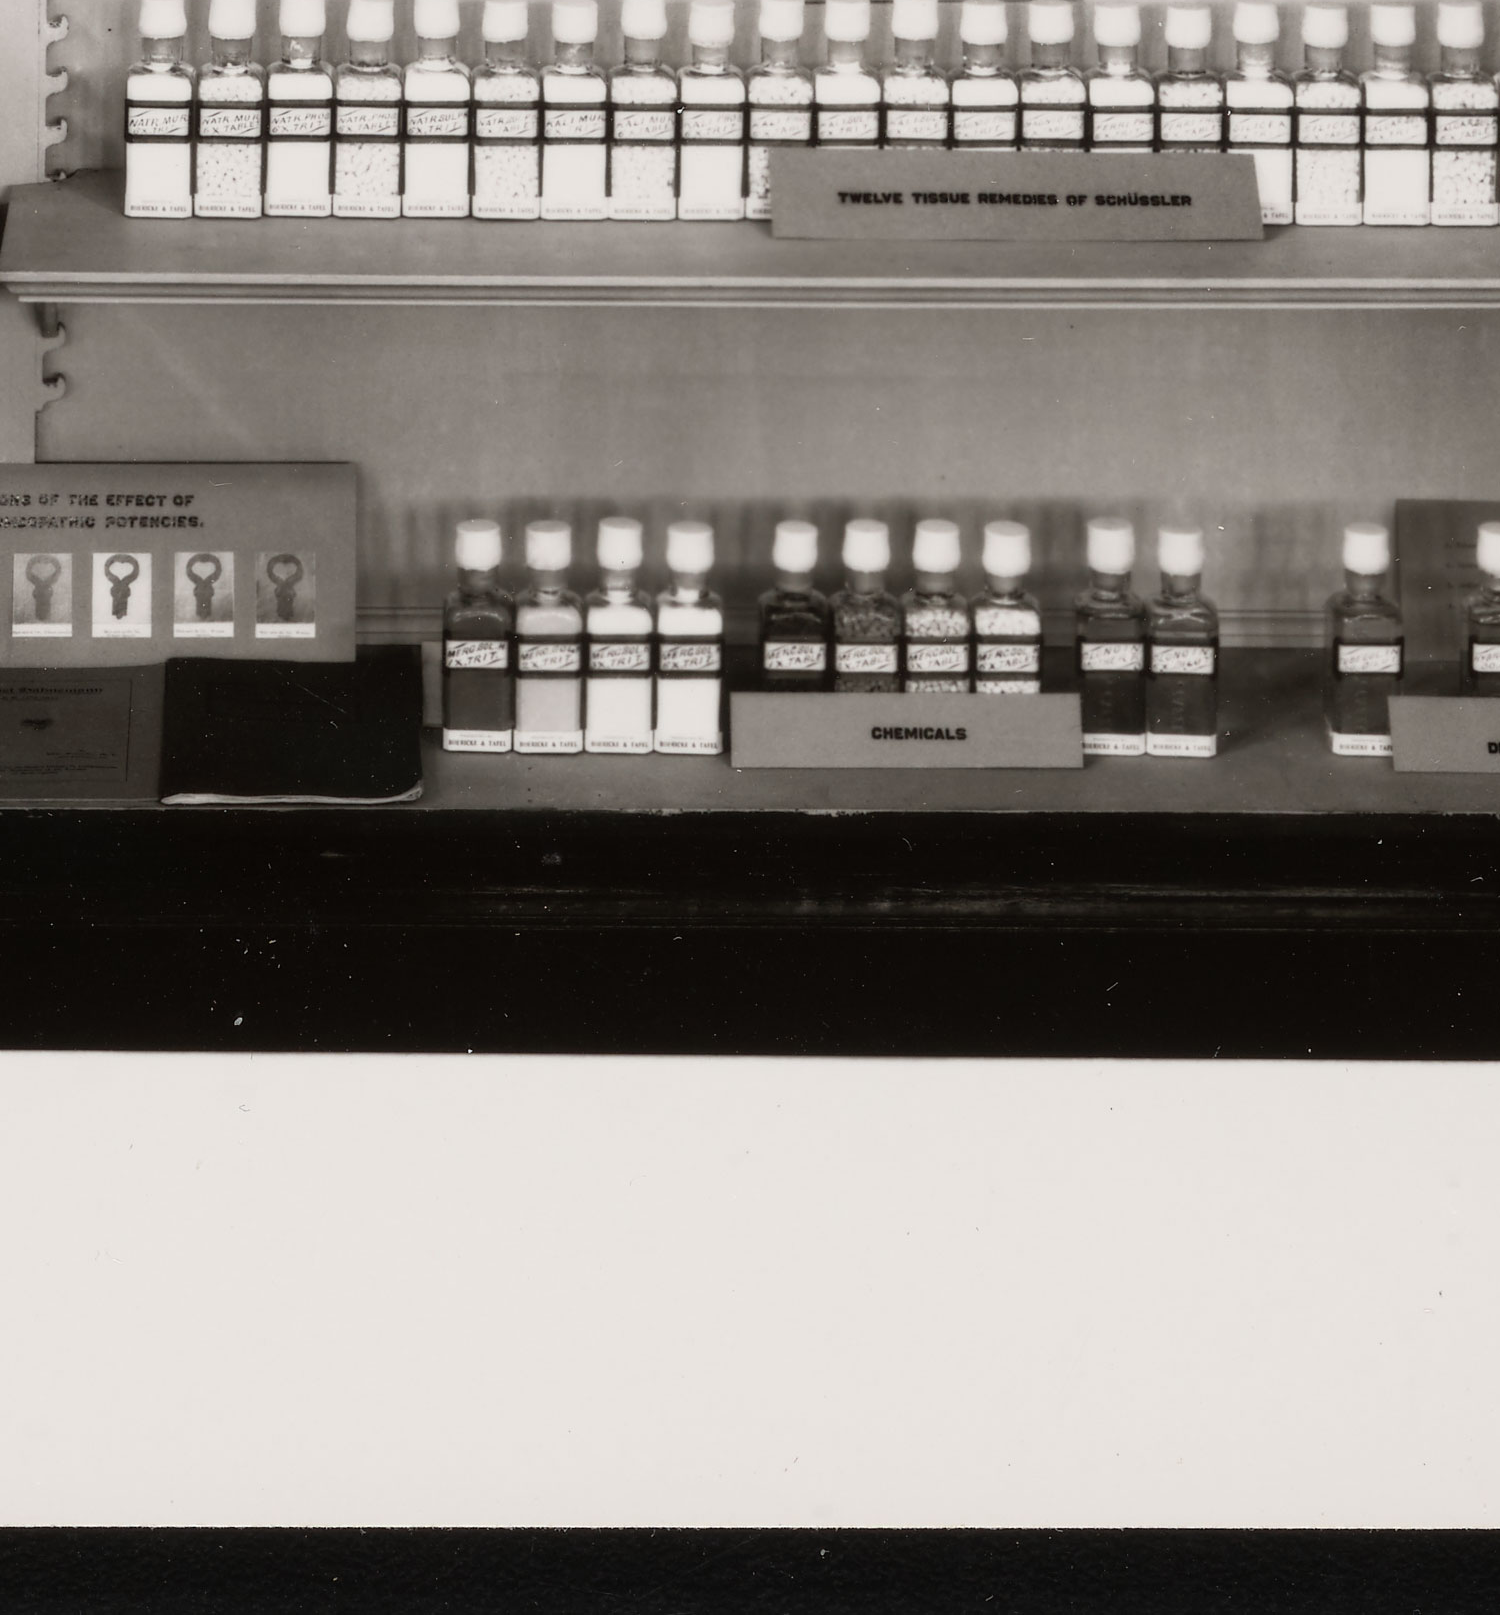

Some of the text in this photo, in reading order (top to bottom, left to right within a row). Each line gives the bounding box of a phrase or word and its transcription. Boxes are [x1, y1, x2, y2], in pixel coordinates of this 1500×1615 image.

[837, 191, 1192, 207] TWELVE TISSUE REMEDIES OF SCHÜSSLER
[39, 495, 59, 507] OF
[69, 494, 99, 508] THE
[105, 494, 166, 508] EFFECT
[173, 494, 195, 508] OF
[104, 516, 204, 529] POTENCIES.
[870, 726, 968, 741] CHEMICALS
